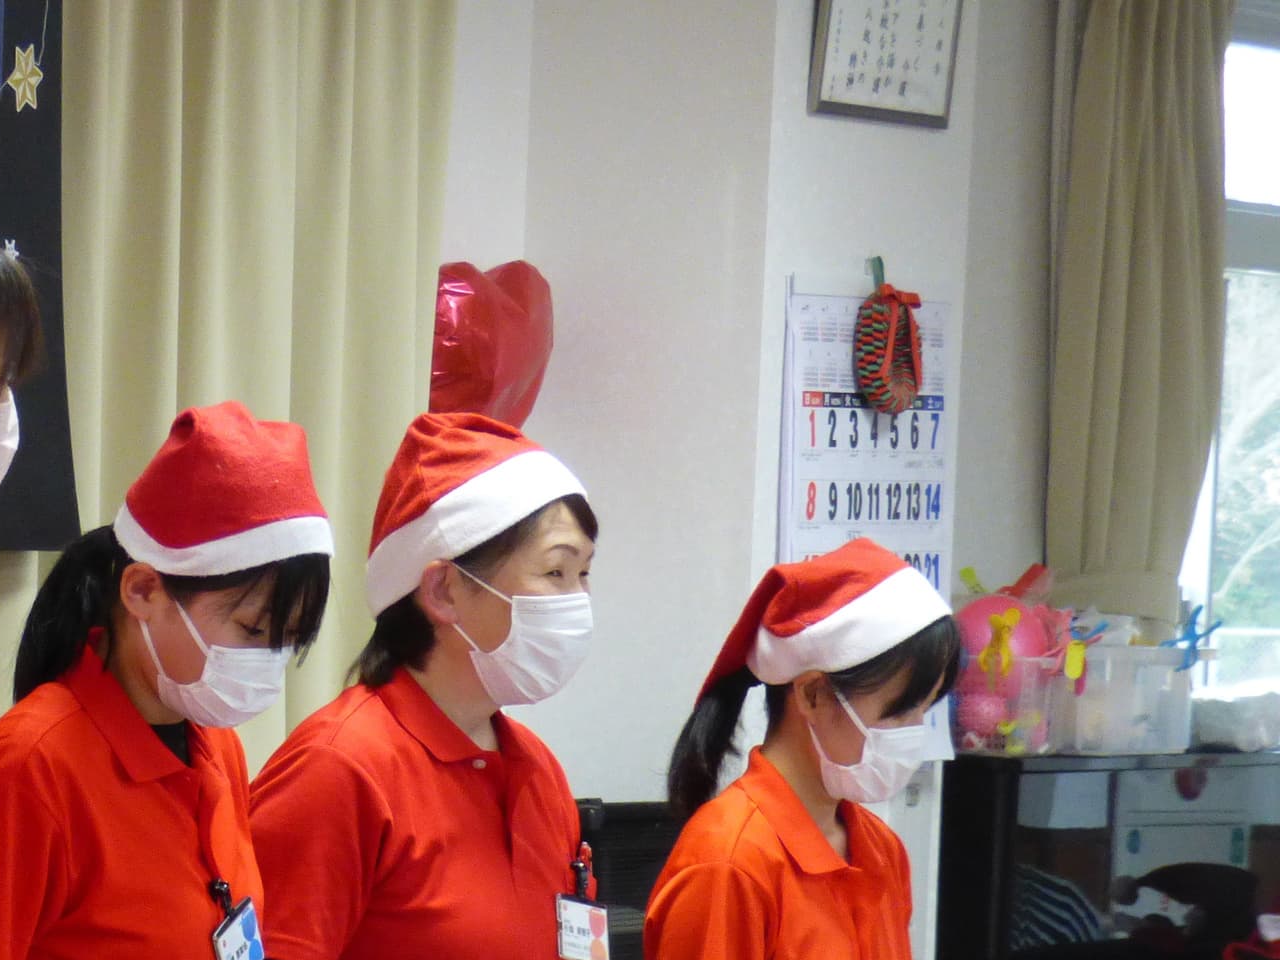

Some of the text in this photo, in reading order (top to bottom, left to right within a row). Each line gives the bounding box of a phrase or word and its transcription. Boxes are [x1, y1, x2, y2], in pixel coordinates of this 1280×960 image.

[809, 409, 939, 450] 1 2 3 4 5 6 7
[806, 481, 941, 521] 8 9 10 11 12 13 14
